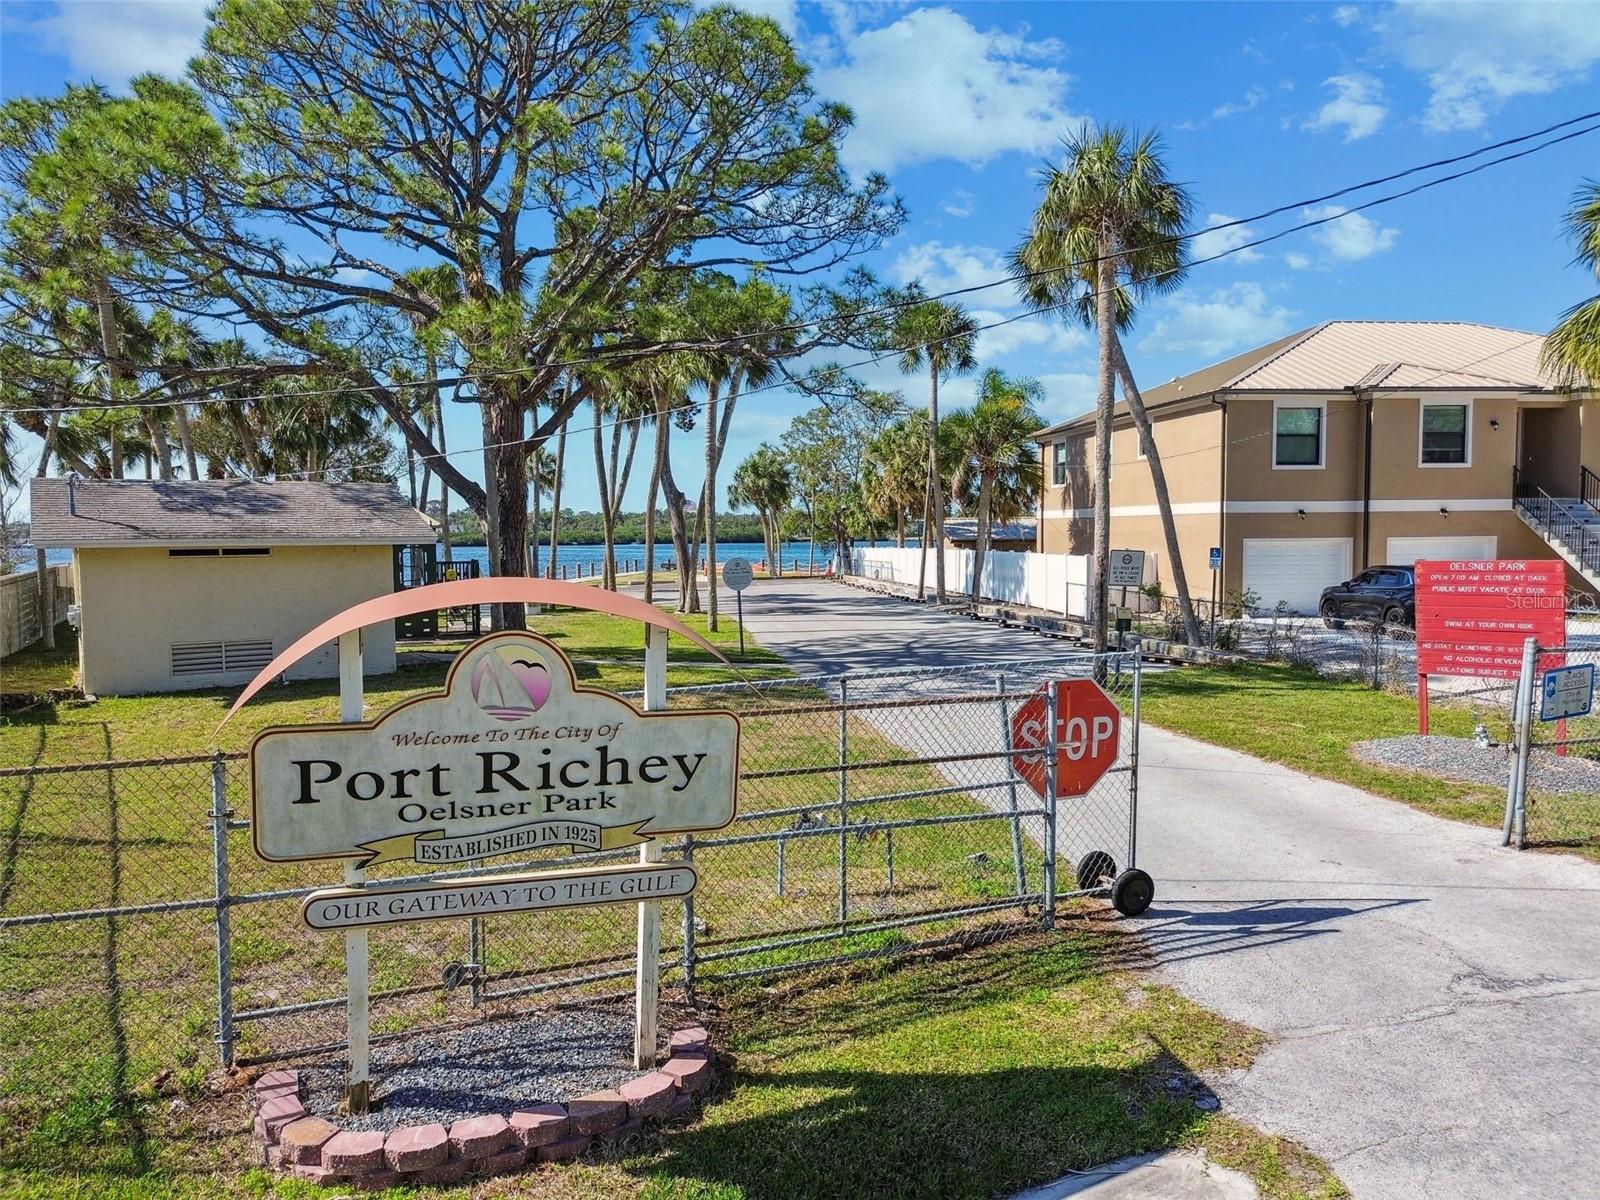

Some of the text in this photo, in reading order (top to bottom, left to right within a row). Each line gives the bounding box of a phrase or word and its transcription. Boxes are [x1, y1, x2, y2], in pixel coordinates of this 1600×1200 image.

[1499, 562, 1526, 570] PARK
[1456, 644, 1492, 652] LAUNCHING
[392, 723, 623, 747] Welcome To The City Of
[1021, 716, 1113, 763] SOP
[291, 746, 708, 805] Port Richey
[398, 792, 616, 823] Oelsner Park
[420, 824, 598, 860] ESTABLISHED IN 1925
[322, 873, 681, 922] OUR GATEWAY TO THE GULF
